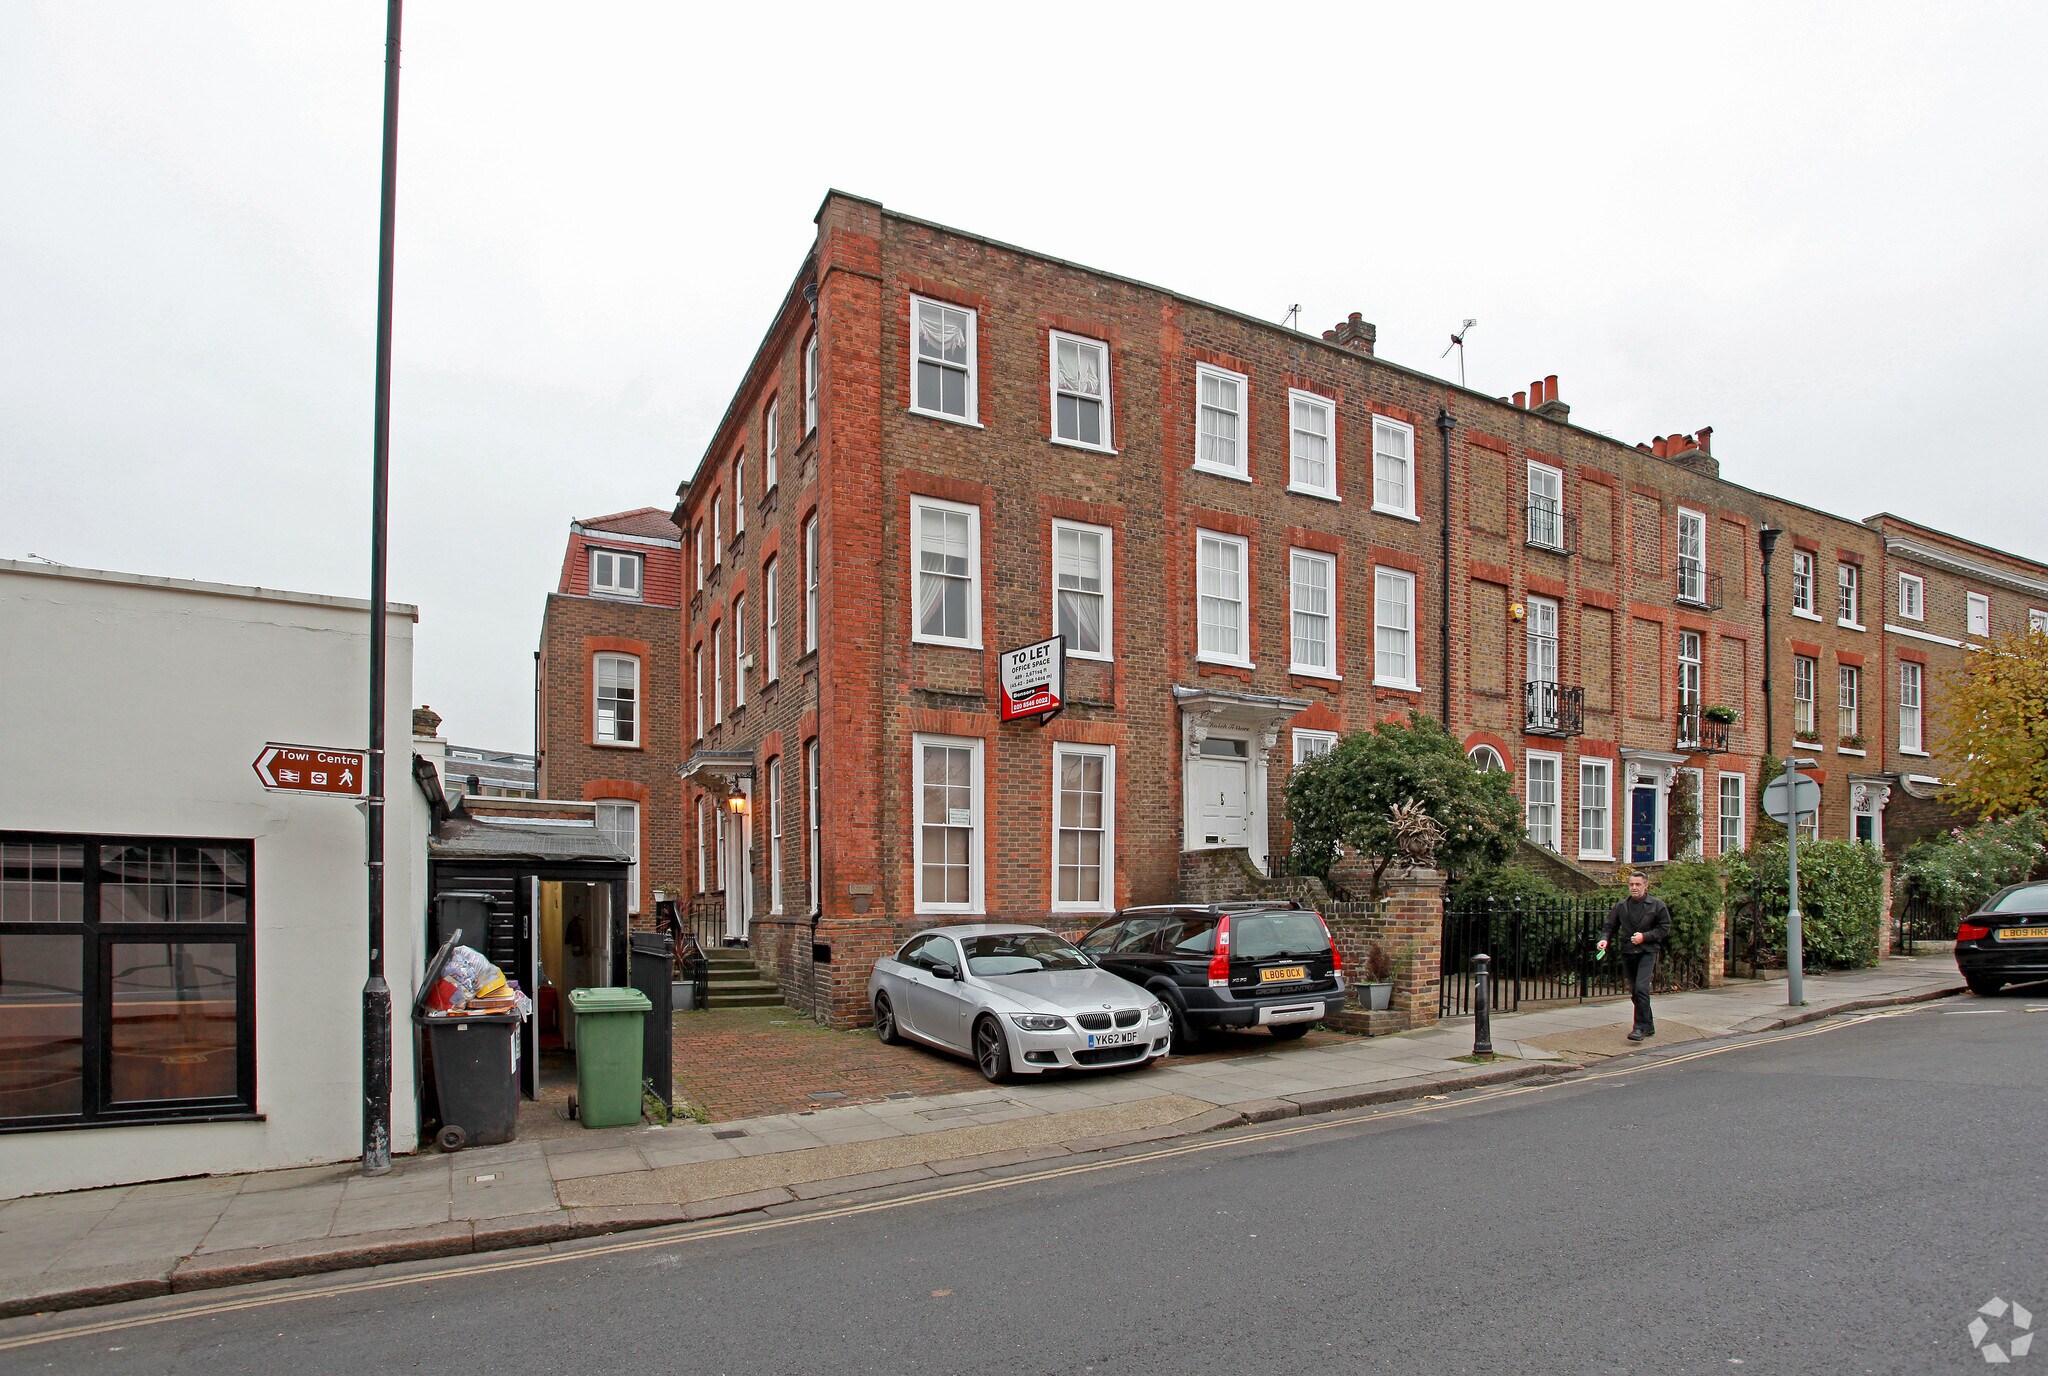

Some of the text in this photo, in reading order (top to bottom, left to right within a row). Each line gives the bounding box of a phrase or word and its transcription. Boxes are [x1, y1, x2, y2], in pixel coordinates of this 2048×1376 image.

[1012, 645, 1050, 665] TO LET
[1012, 658, 1050, 673] OFFICE SPACE
[317, 752, 359, 765] Centre
[2004, 929, 2028, 937] LB09
[1264, 968, 1301, 979] LB06 OCX
[1095, 1034, 1119, 1045] YK62
[1121, 1032, 1137, 1042] WDF
